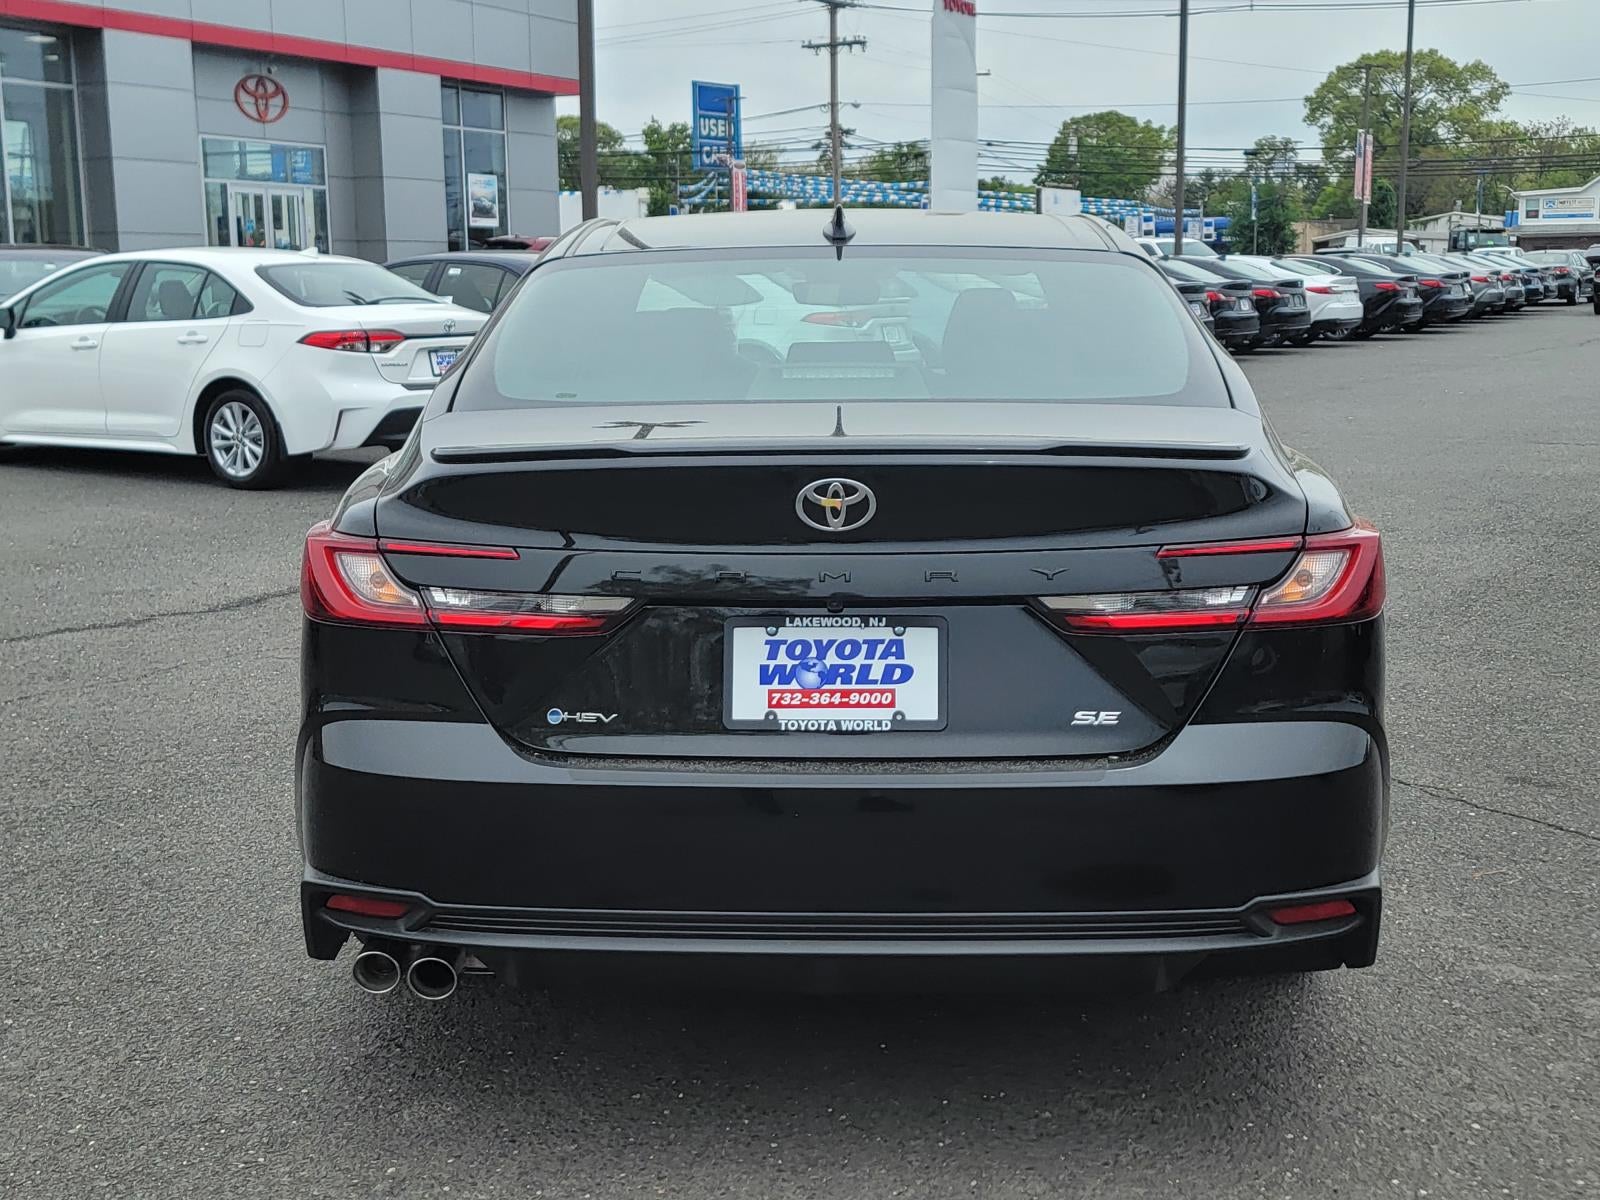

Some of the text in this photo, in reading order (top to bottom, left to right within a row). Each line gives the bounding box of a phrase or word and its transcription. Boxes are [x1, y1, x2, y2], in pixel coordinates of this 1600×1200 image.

[700, 117, 735, 137] USED
[610, 567, 1070, 583] CAMRY
[785, 616, 887, 629] LAKEWOOD, NJ
[764, 638, 906, 661] TOYOTA
[770, 692, 893, 706] 732-364-9000
[778, 719, 892, 732] TOYOTA WORLD
[1070, 710, 1122, 726] SE
